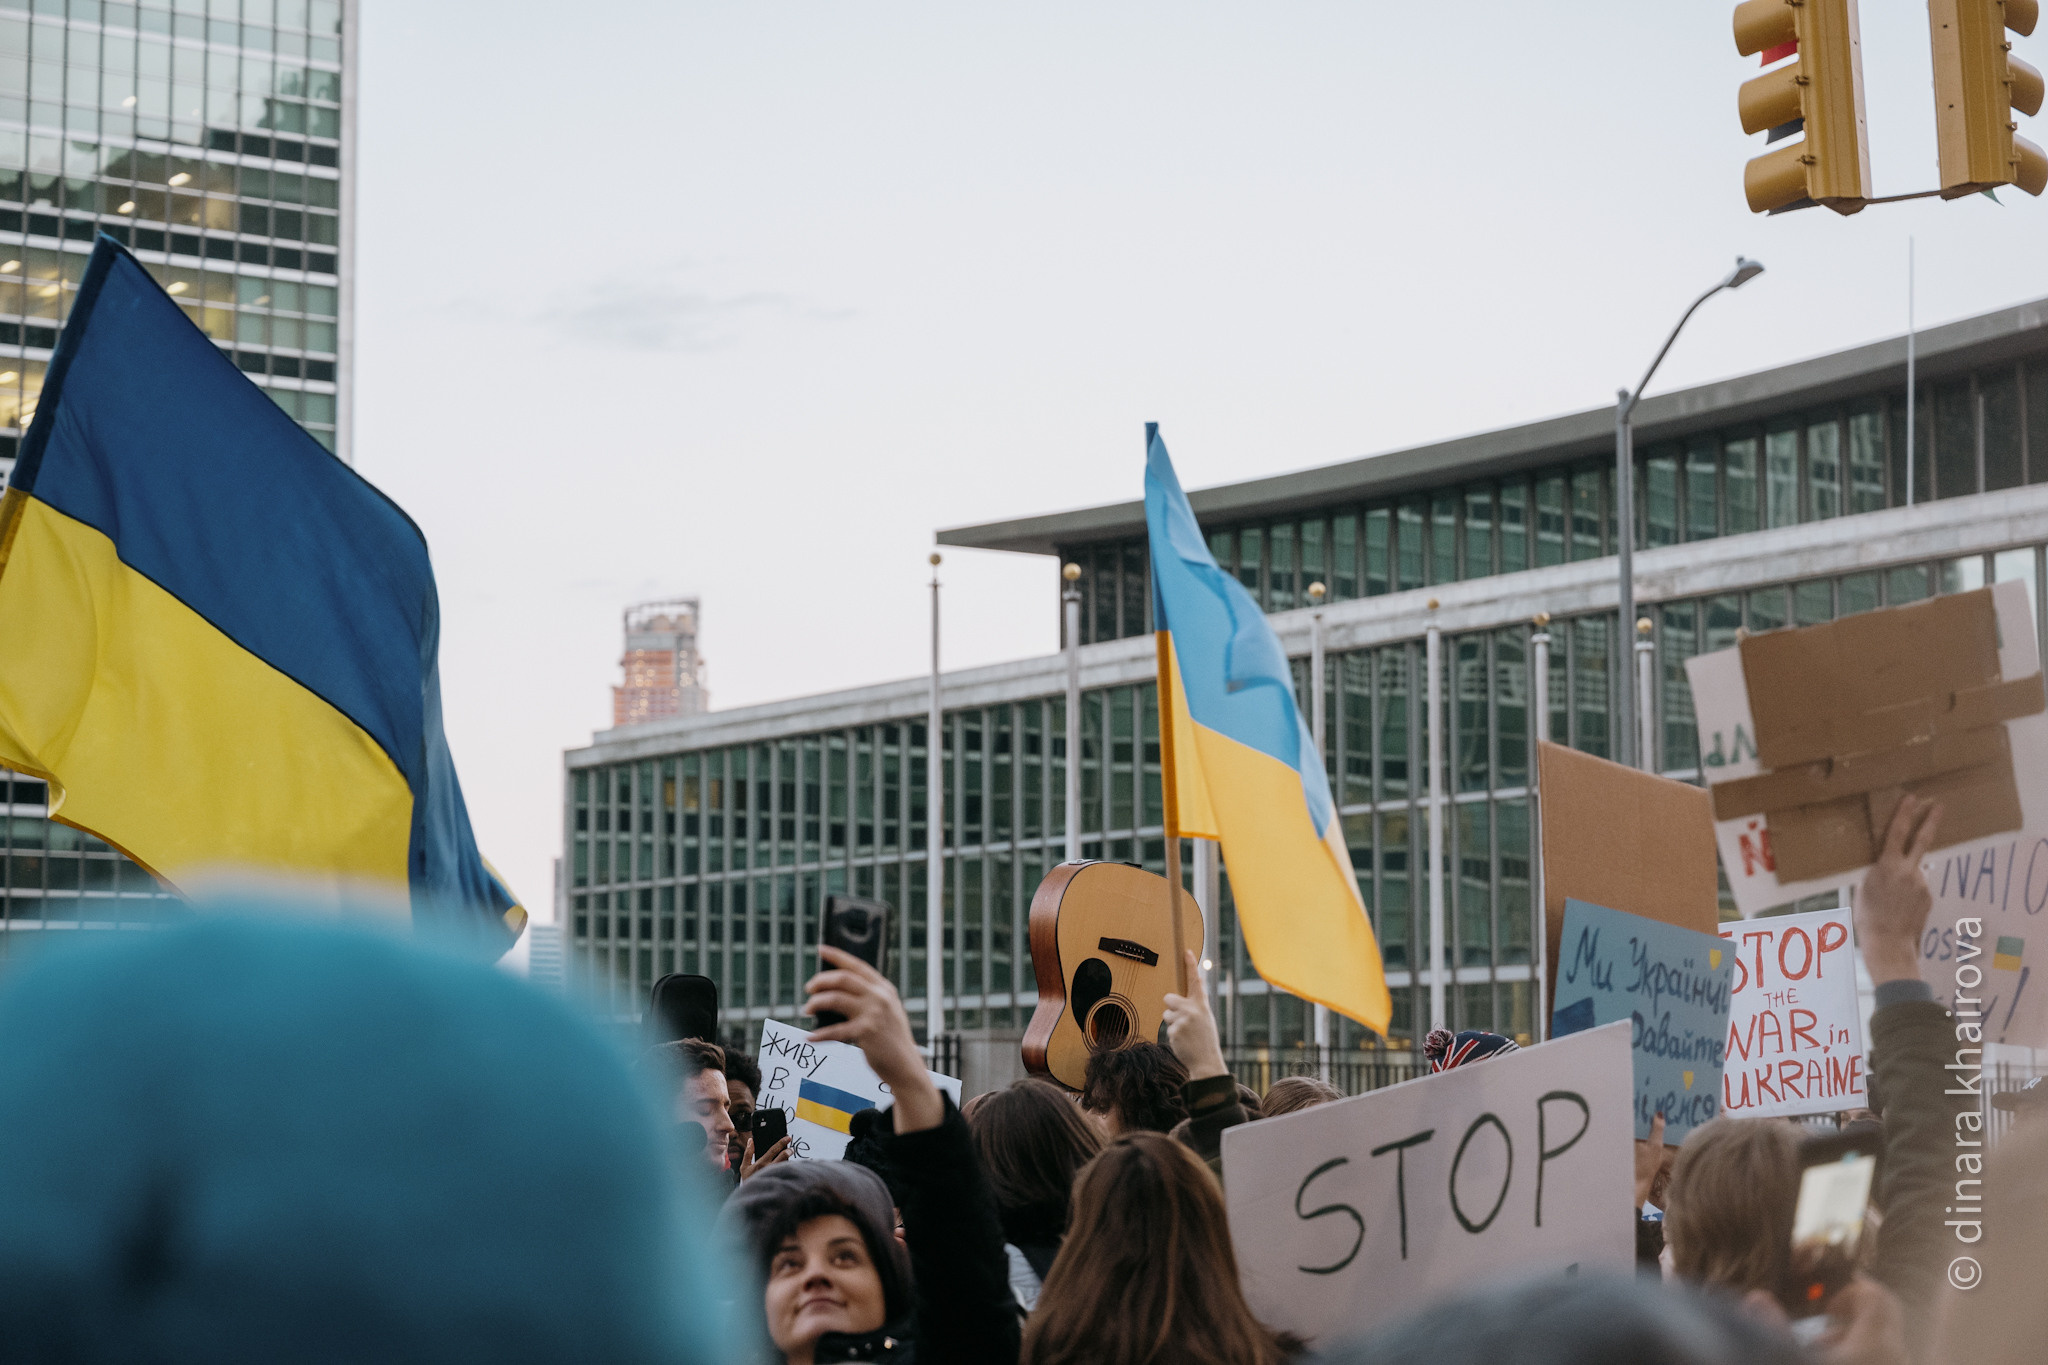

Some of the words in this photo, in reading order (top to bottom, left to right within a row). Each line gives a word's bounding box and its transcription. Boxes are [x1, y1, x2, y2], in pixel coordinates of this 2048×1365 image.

[1763, 987, 1799, 1009] THE
[1829, 1023, 1850, 1045] in
[1724, 1055, 1863, 1110] UKRAINE
[1295, 1091, 1590, 1275] STOP
